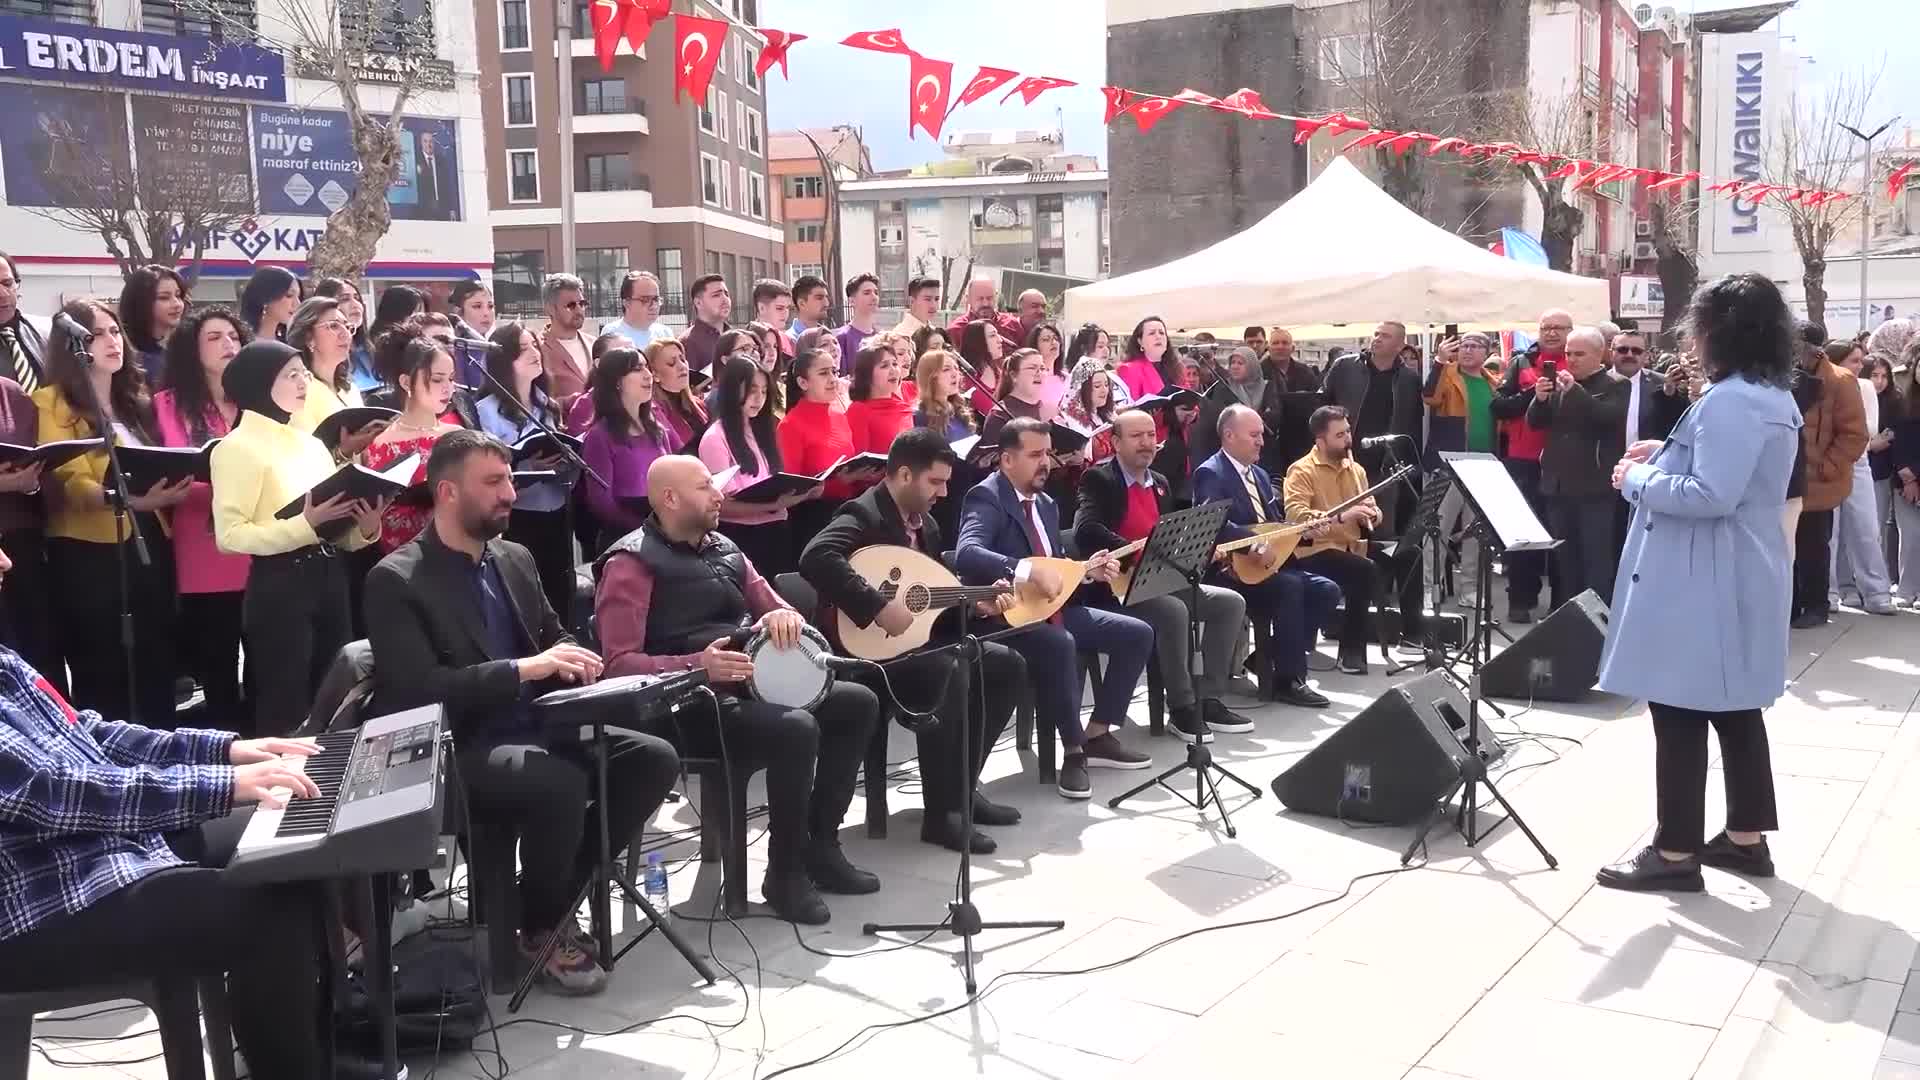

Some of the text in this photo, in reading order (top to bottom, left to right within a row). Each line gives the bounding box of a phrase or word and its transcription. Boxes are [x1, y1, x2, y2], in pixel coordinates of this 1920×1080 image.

[22, 31, 186, 81] ERDEM
[192, 64, 268, 89] İNŞAAT
[260, 112, 333, 127] Bugüne kadar
[260, 127, 314, 156] niye
[262, 158, 358, 172] masraf ettiniz?
